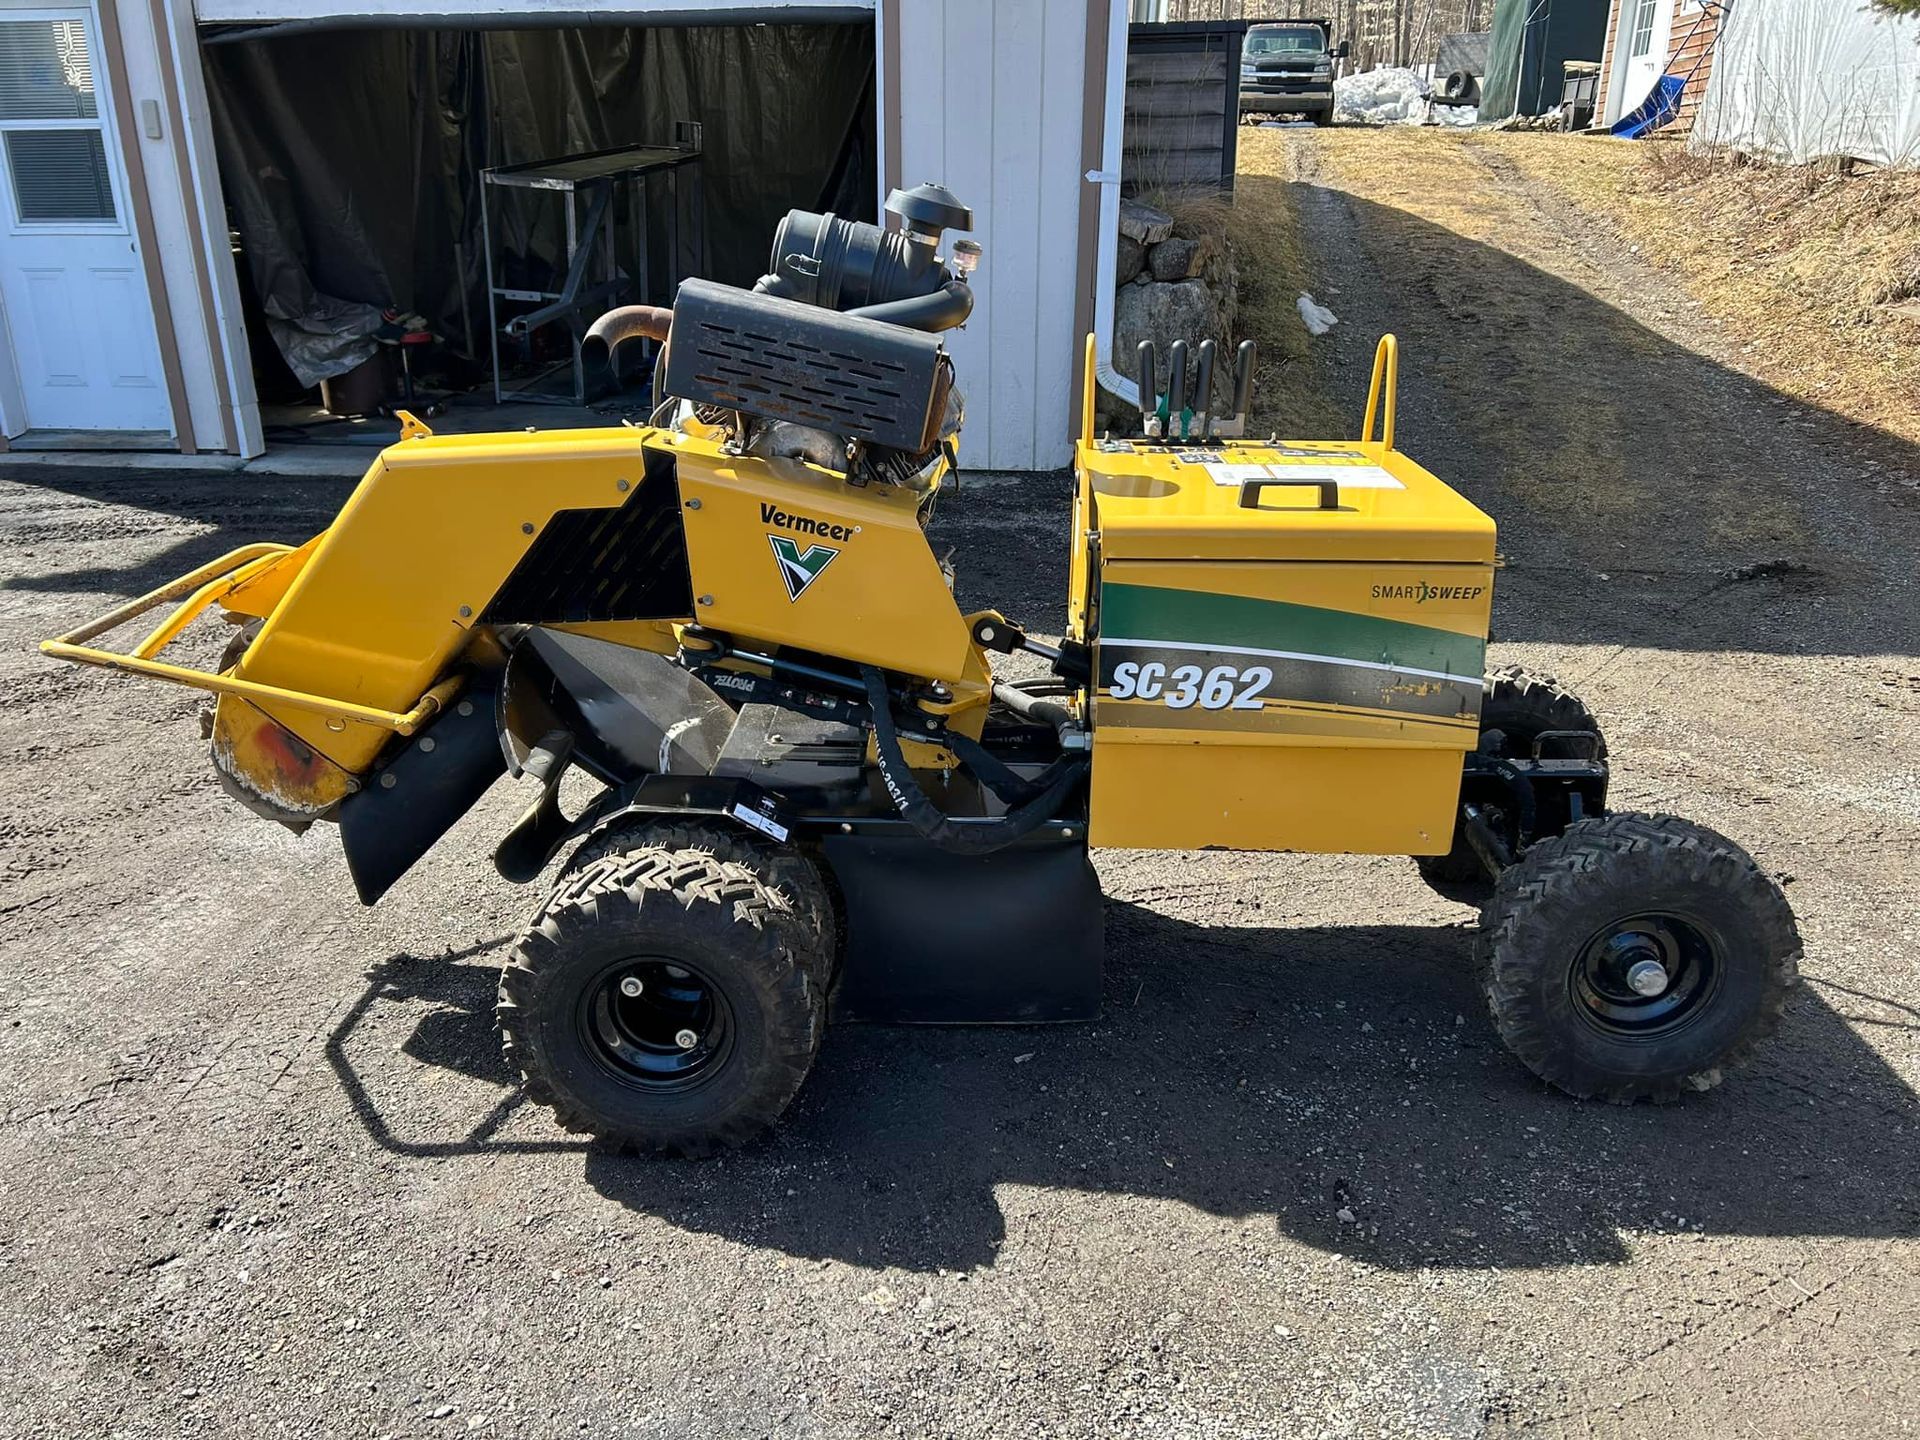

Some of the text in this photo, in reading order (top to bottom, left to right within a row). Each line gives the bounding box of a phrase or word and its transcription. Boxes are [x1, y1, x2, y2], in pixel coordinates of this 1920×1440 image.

[760, 502, 854, 542] Vermeer
[1371, 584, 1483, 600] SMART SWEEP
